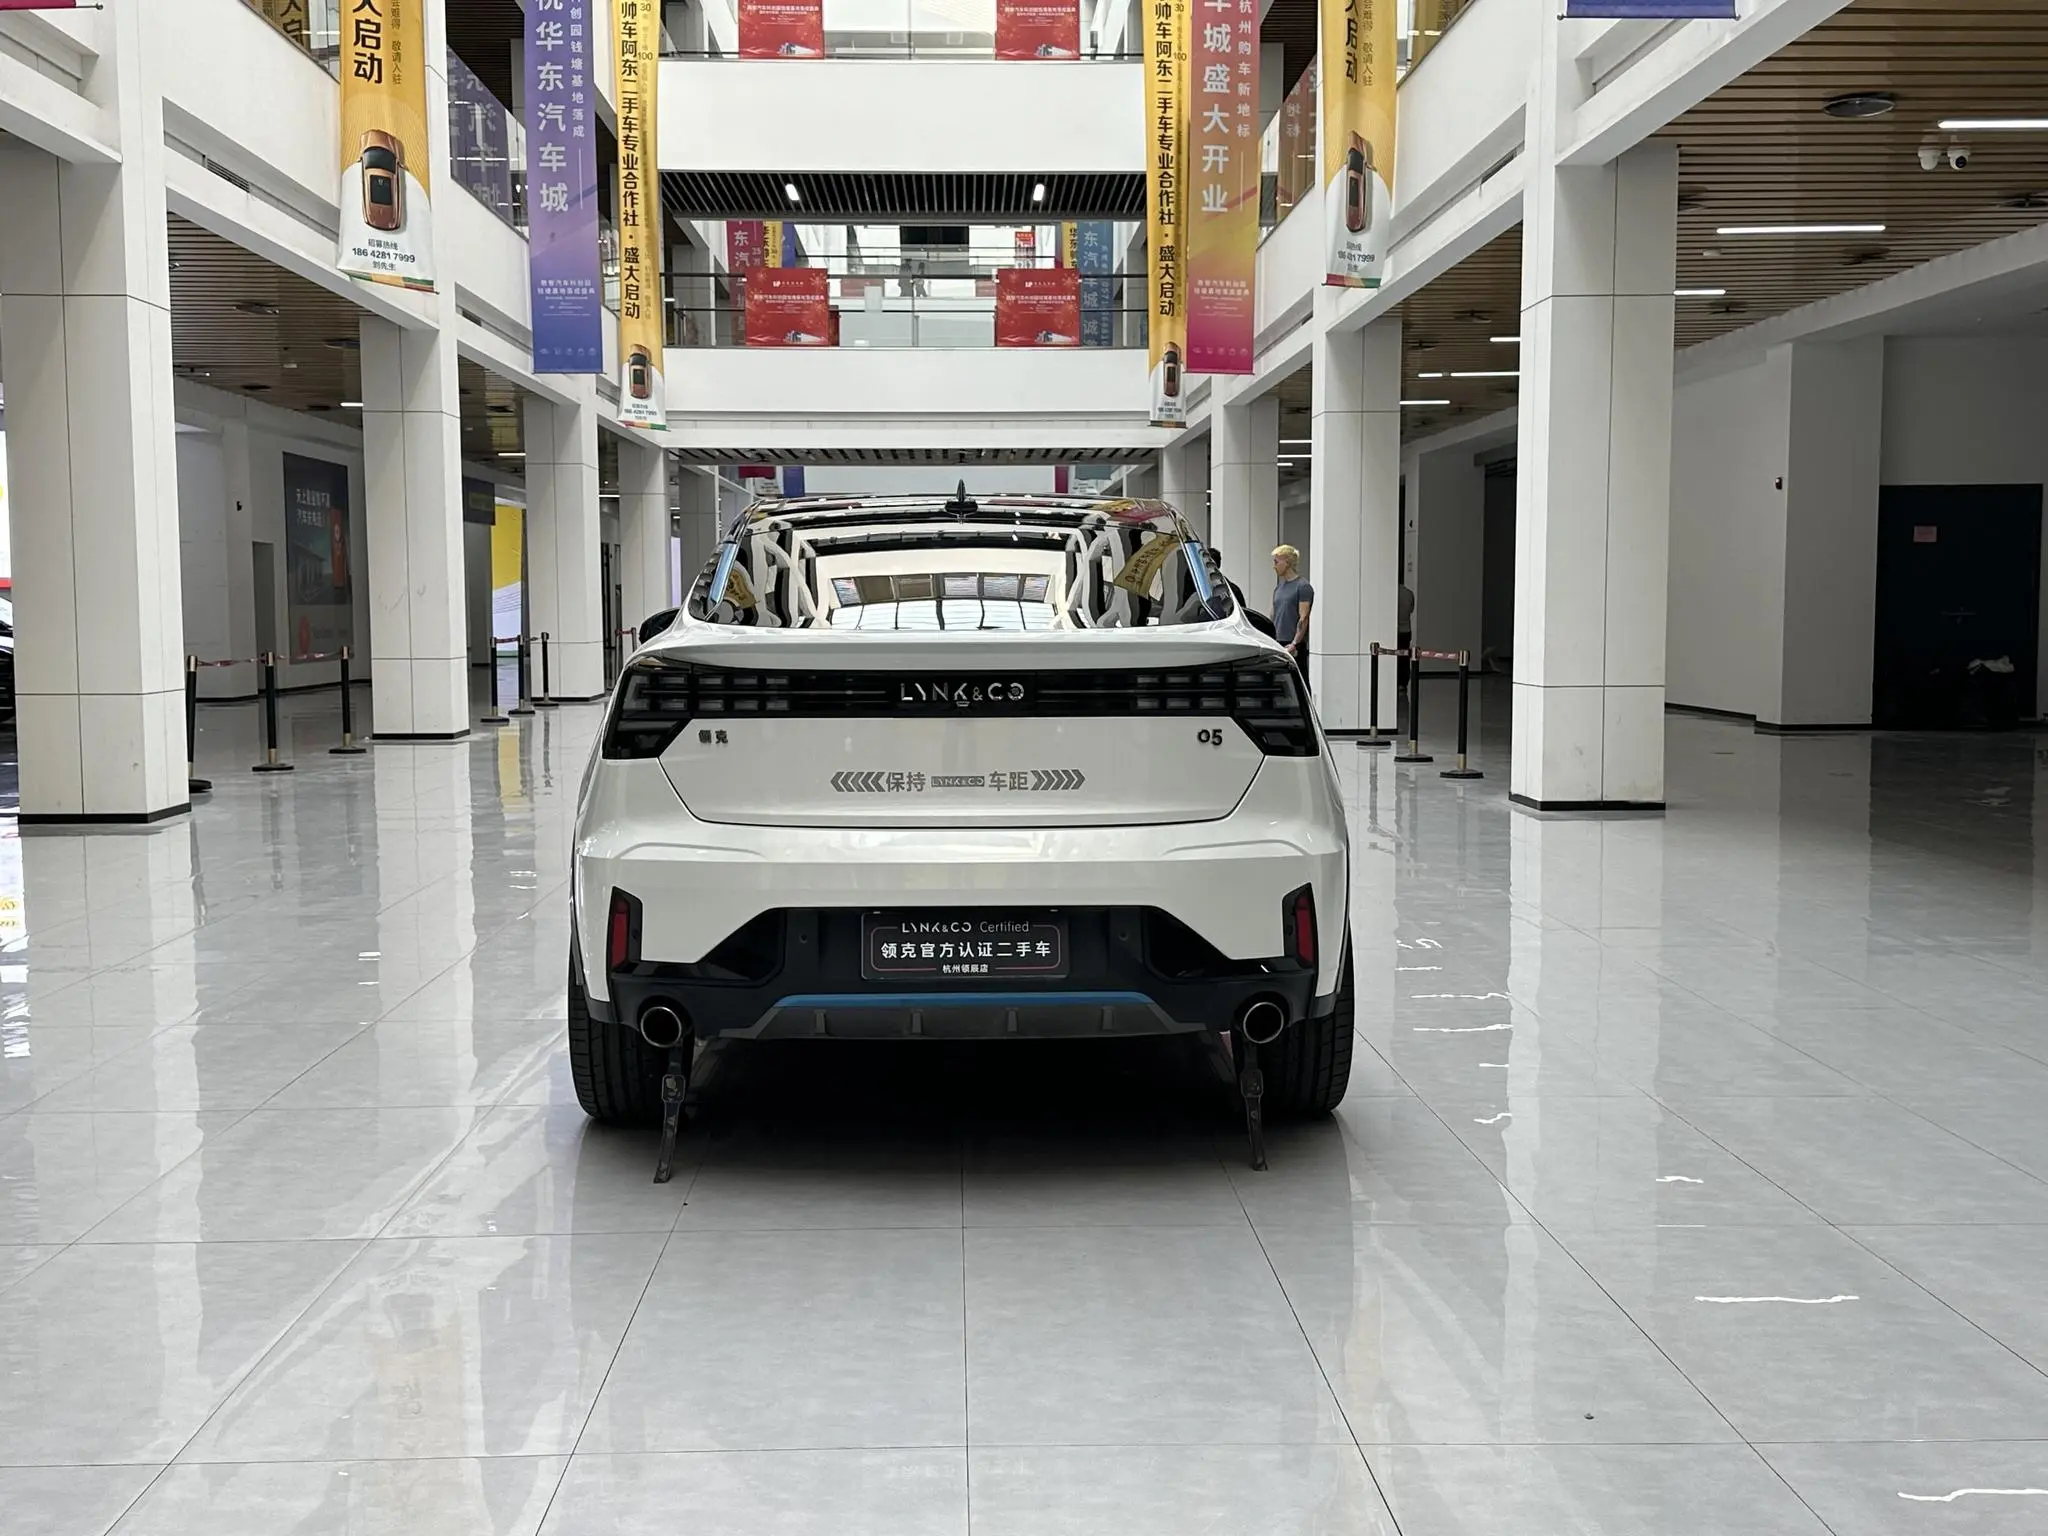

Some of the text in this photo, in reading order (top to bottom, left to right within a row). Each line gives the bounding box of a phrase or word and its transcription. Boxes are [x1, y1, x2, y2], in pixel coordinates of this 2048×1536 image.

[352, 248, 415, 263] 186 4281 7999
[1197, 729, 1223, 745] 05
[886, 772, 926, 792] 保持
[989, 771, 1028, 791] 车距
[979, 921, 1030, 933] Certified
[881, 941, 1051, 959] 领克官方认证二手车
